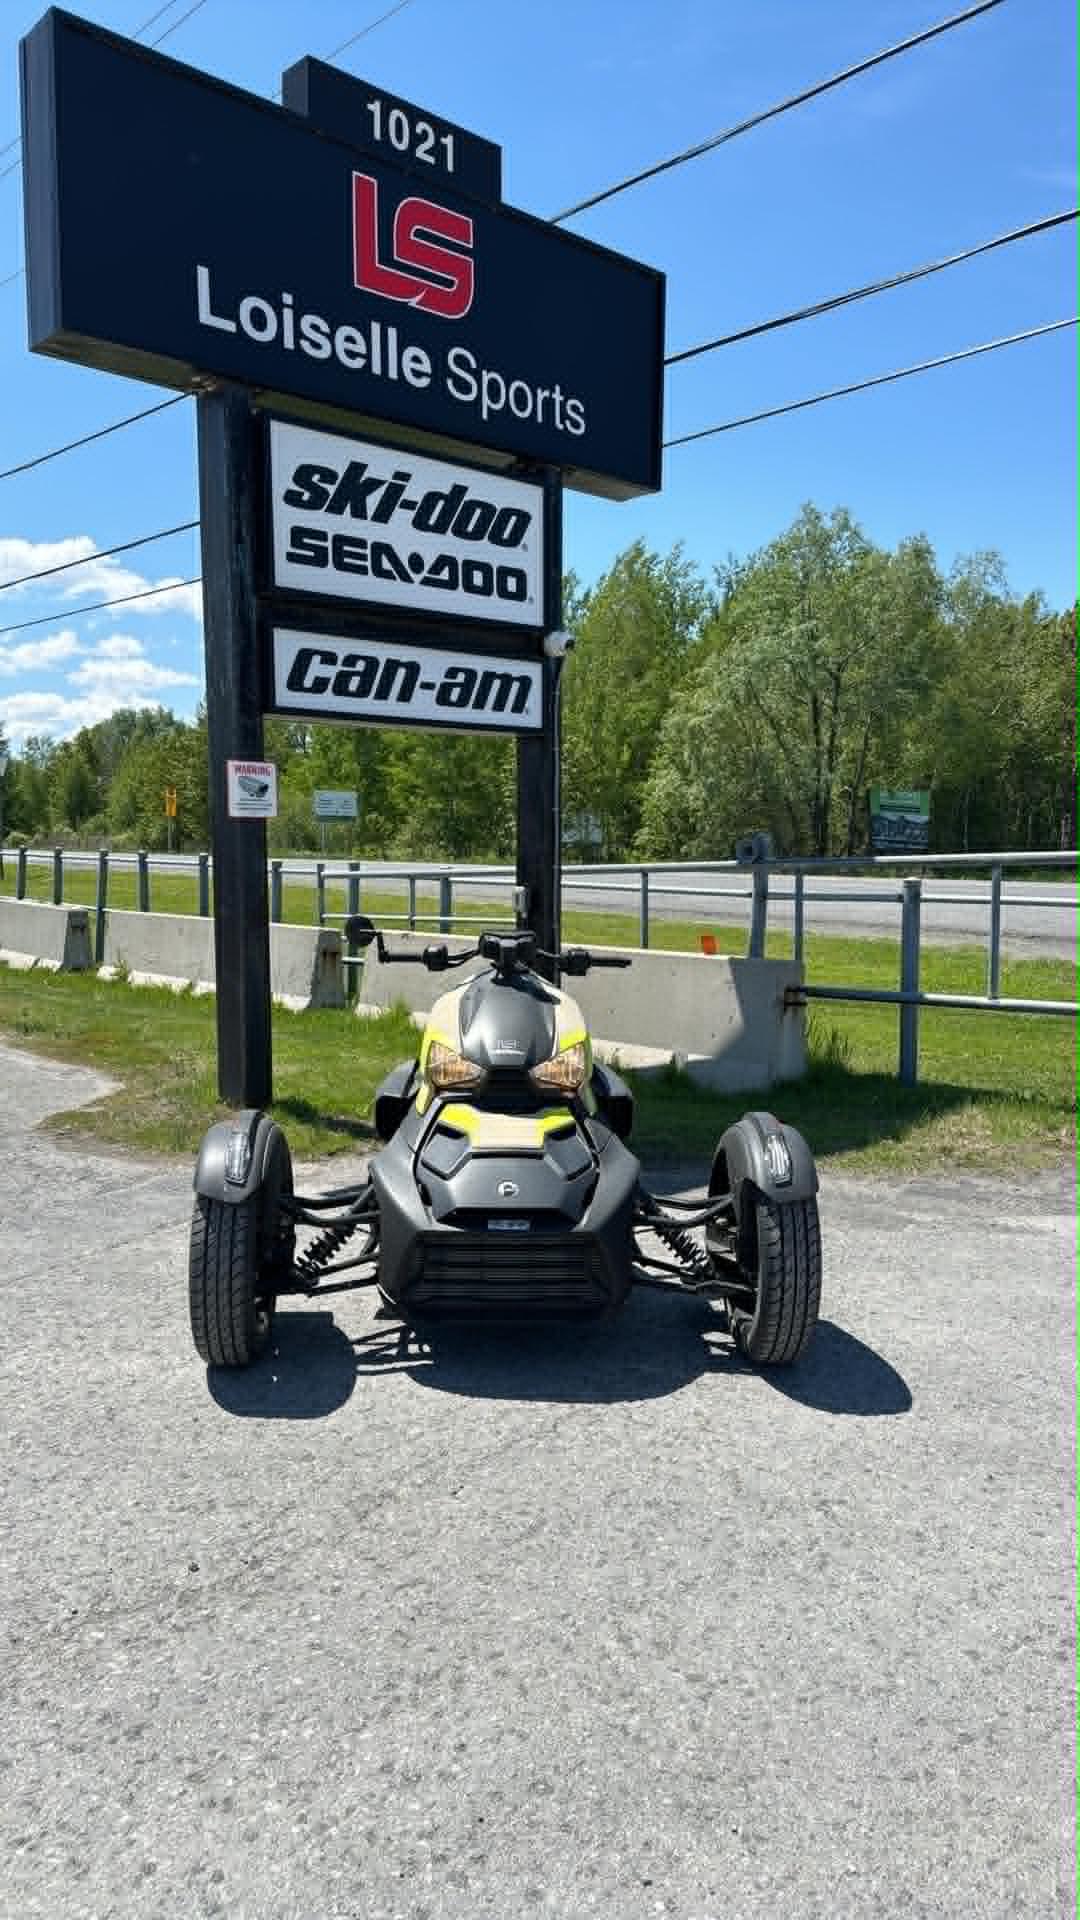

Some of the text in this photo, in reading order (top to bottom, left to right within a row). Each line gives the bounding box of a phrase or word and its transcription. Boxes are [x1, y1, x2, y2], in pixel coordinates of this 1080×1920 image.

[367, 100, 455, 172] 1021
[351, 170, 475, 320] LS
[196, 265, 587, 436] Loiselle Sports
[285, 647, 533, 715] can-am
